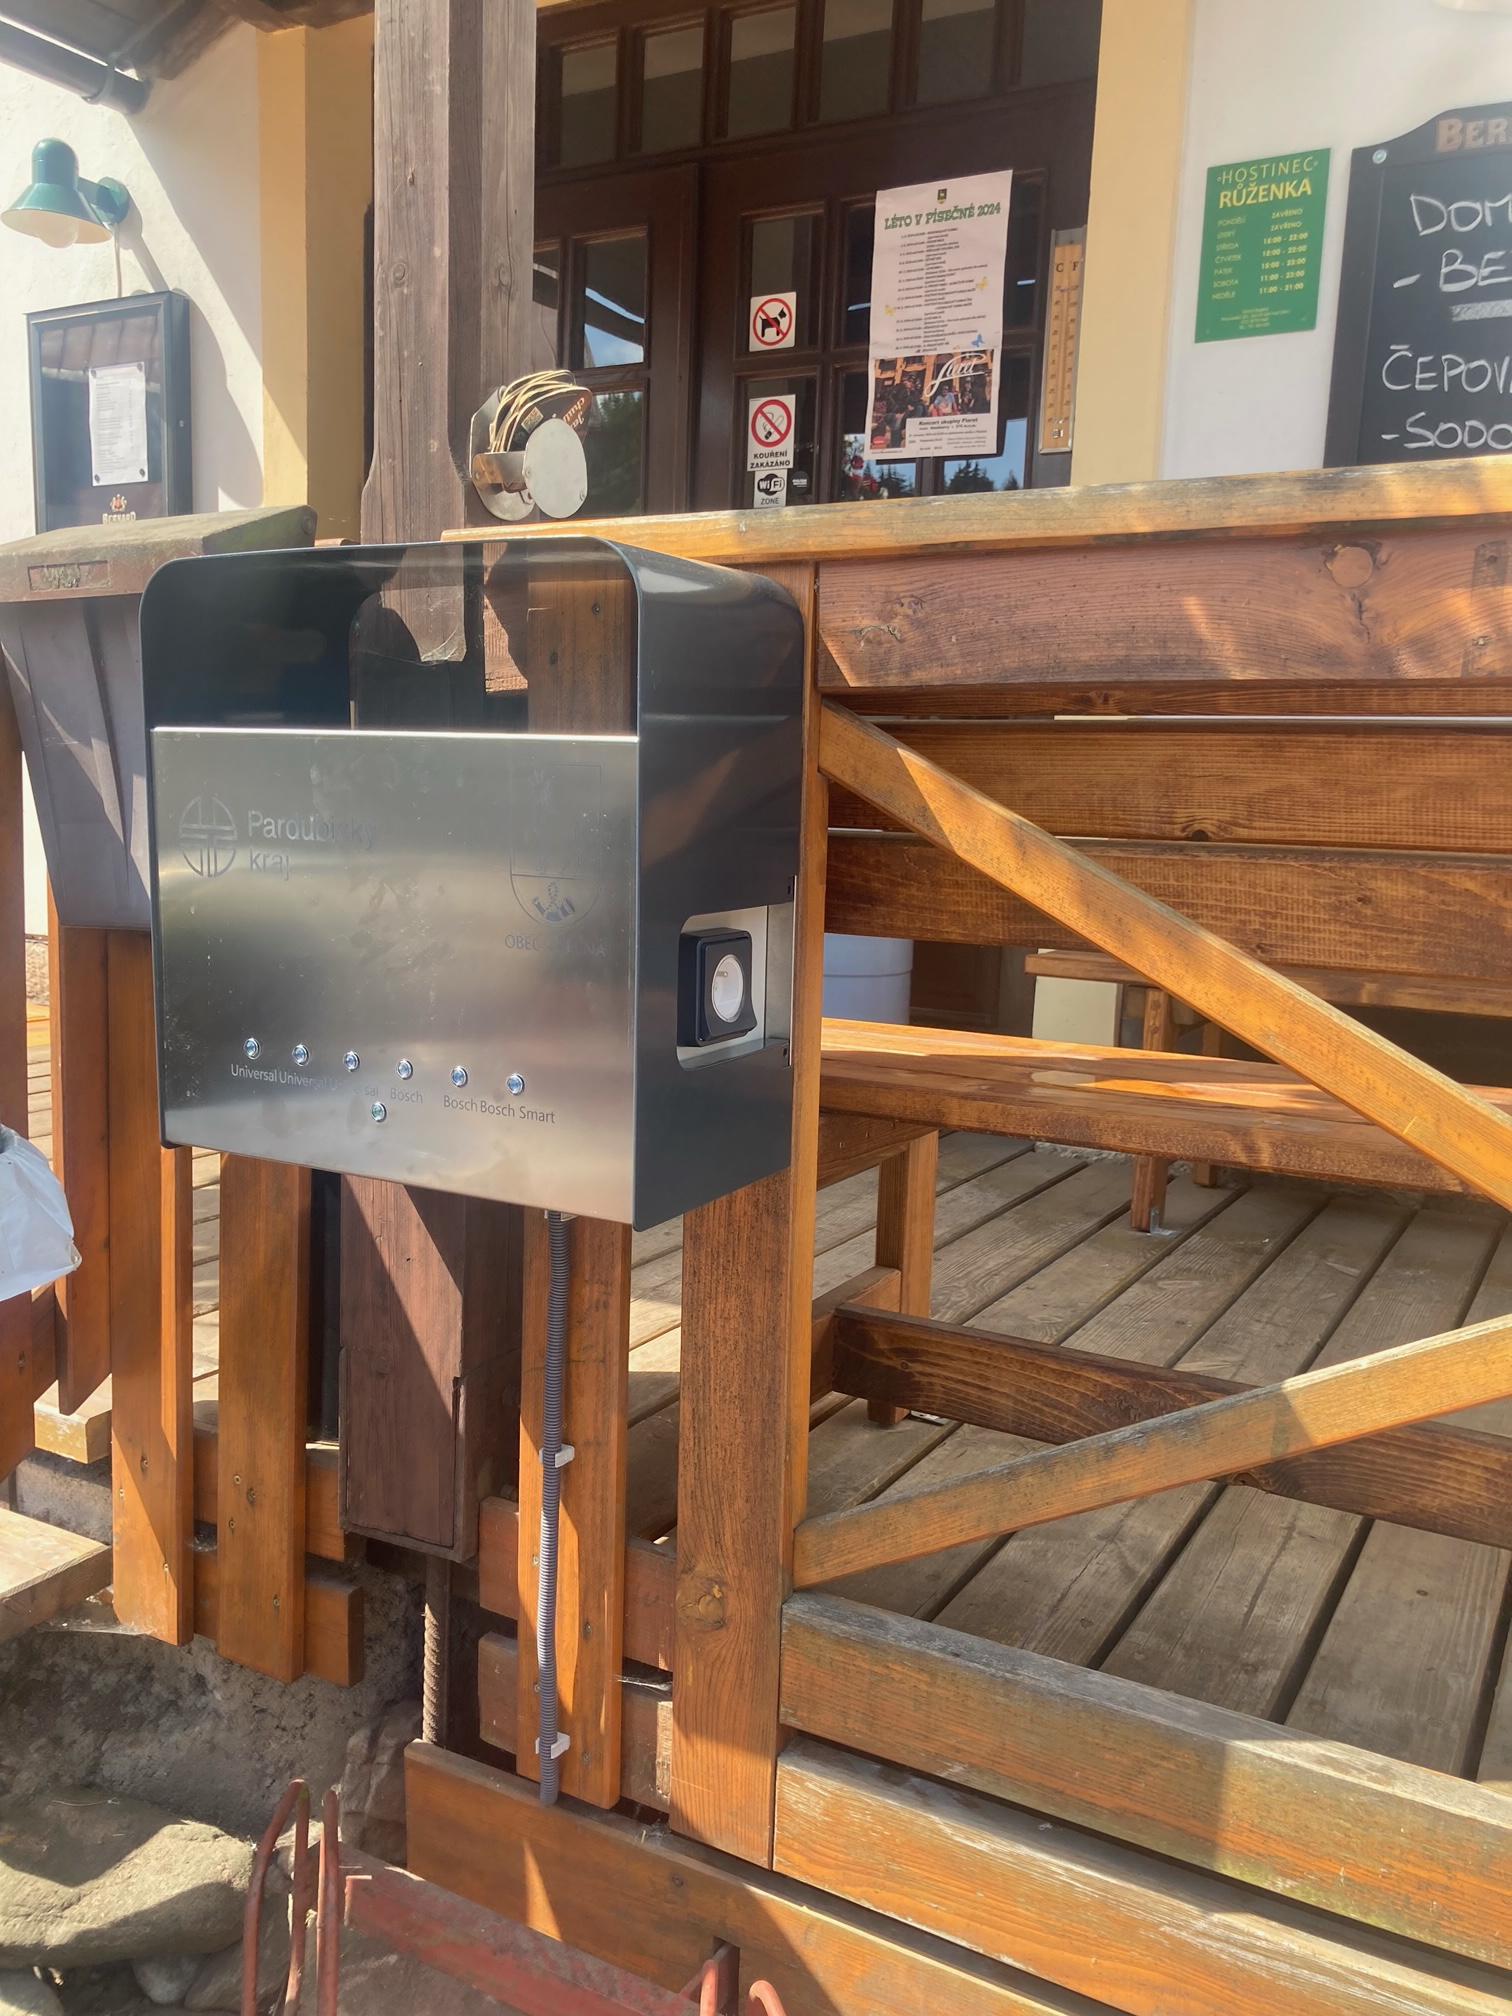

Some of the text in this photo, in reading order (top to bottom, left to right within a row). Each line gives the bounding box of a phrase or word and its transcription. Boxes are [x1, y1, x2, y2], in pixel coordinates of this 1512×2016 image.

[1437, 117, 1512, 152] BER
[1222, 156, 1313, 185] HOSTINEC
[1219, 178, 1312, 209] RŮŽENKA
[884, 202, 1001, 230] LÉTO V PÍSEČNÉ 2024
[1382, 344, 1512, 394] ČEPOV
[753, 450, 788, 459] KOUŘENÍ
[760, 497, 780, 505] ZONE
[249, 847, 290, 881] kraj
[231, 1063, 278, 1082] Universal
[390, 1087, 424, 1104] Bosch
[443, 1095, 556, 1124] Bosch Bosch Smart
